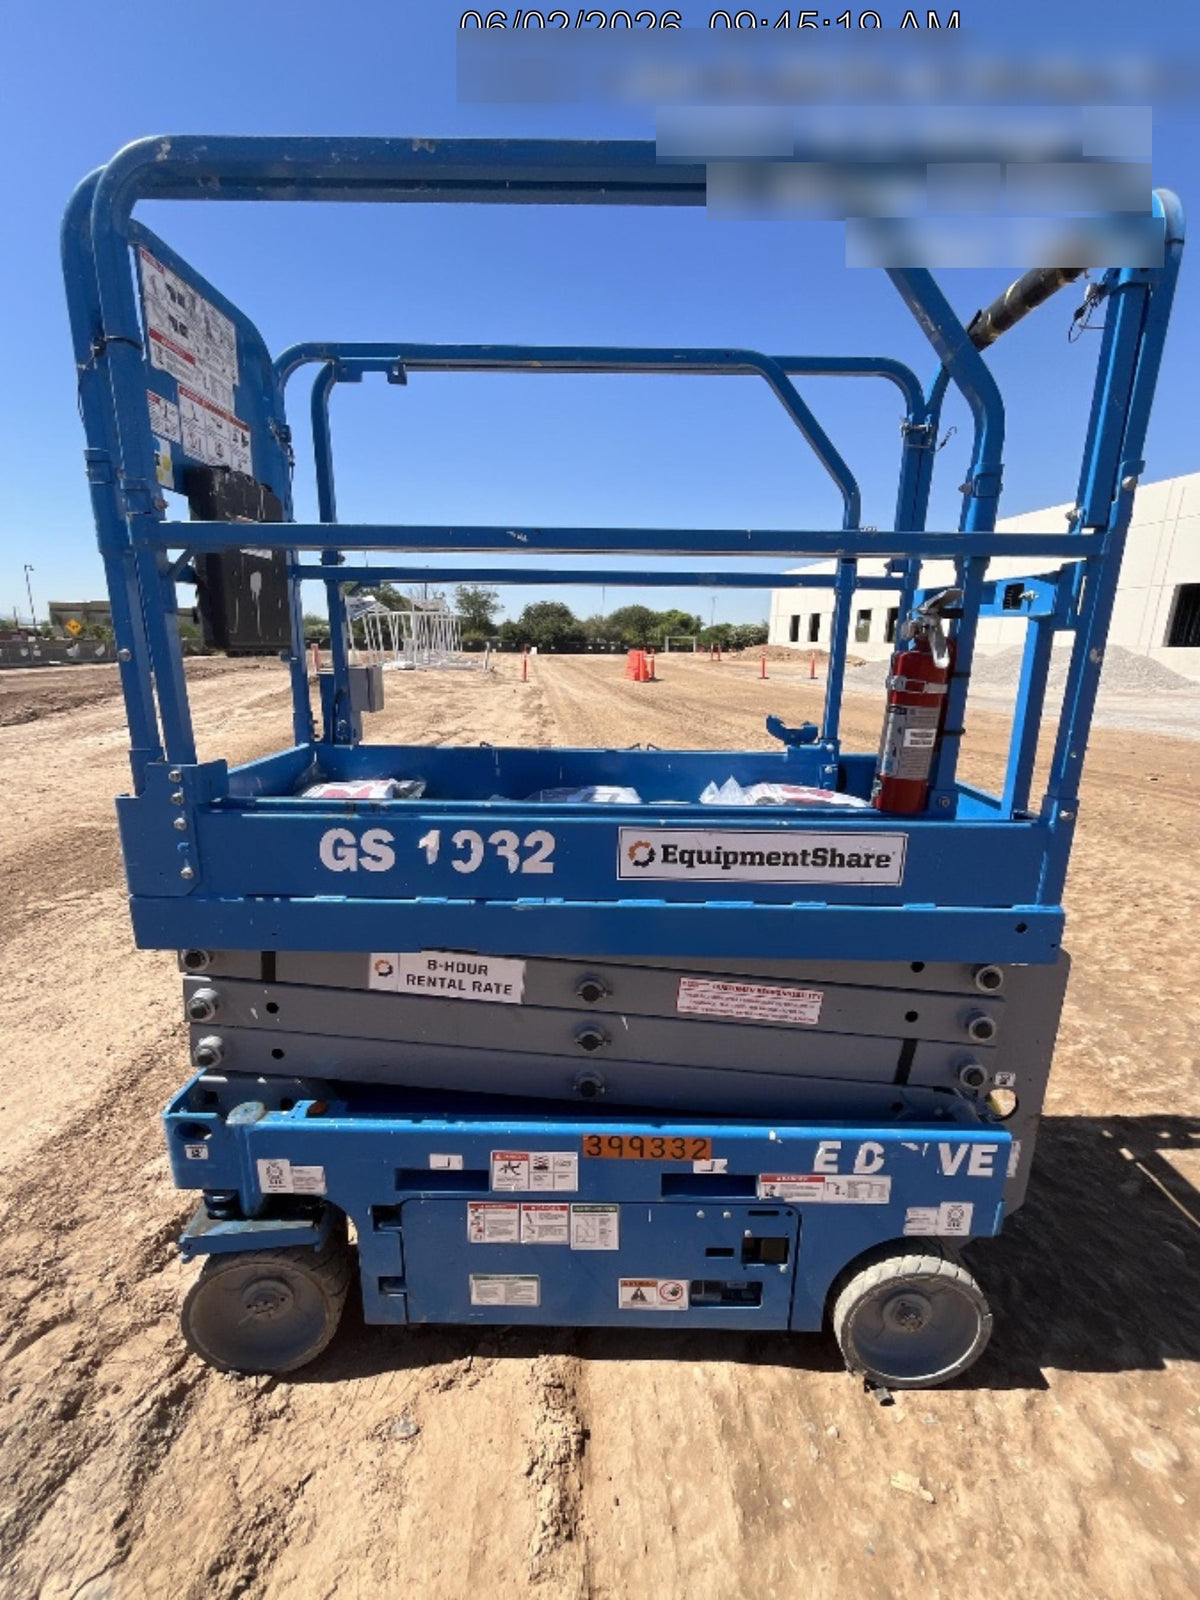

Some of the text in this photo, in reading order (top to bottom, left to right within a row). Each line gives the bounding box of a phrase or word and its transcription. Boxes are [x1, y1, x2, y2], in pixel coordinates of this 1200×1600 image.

[319, 828, 396, 872] GS
[661, 843, 892, 870] EquipmentShare
[427, 959, 489, 976] 8-HOUR
[406, 973, 513, 996] RENTAL RATE
[586, 1135, 708, 1160] 399332
